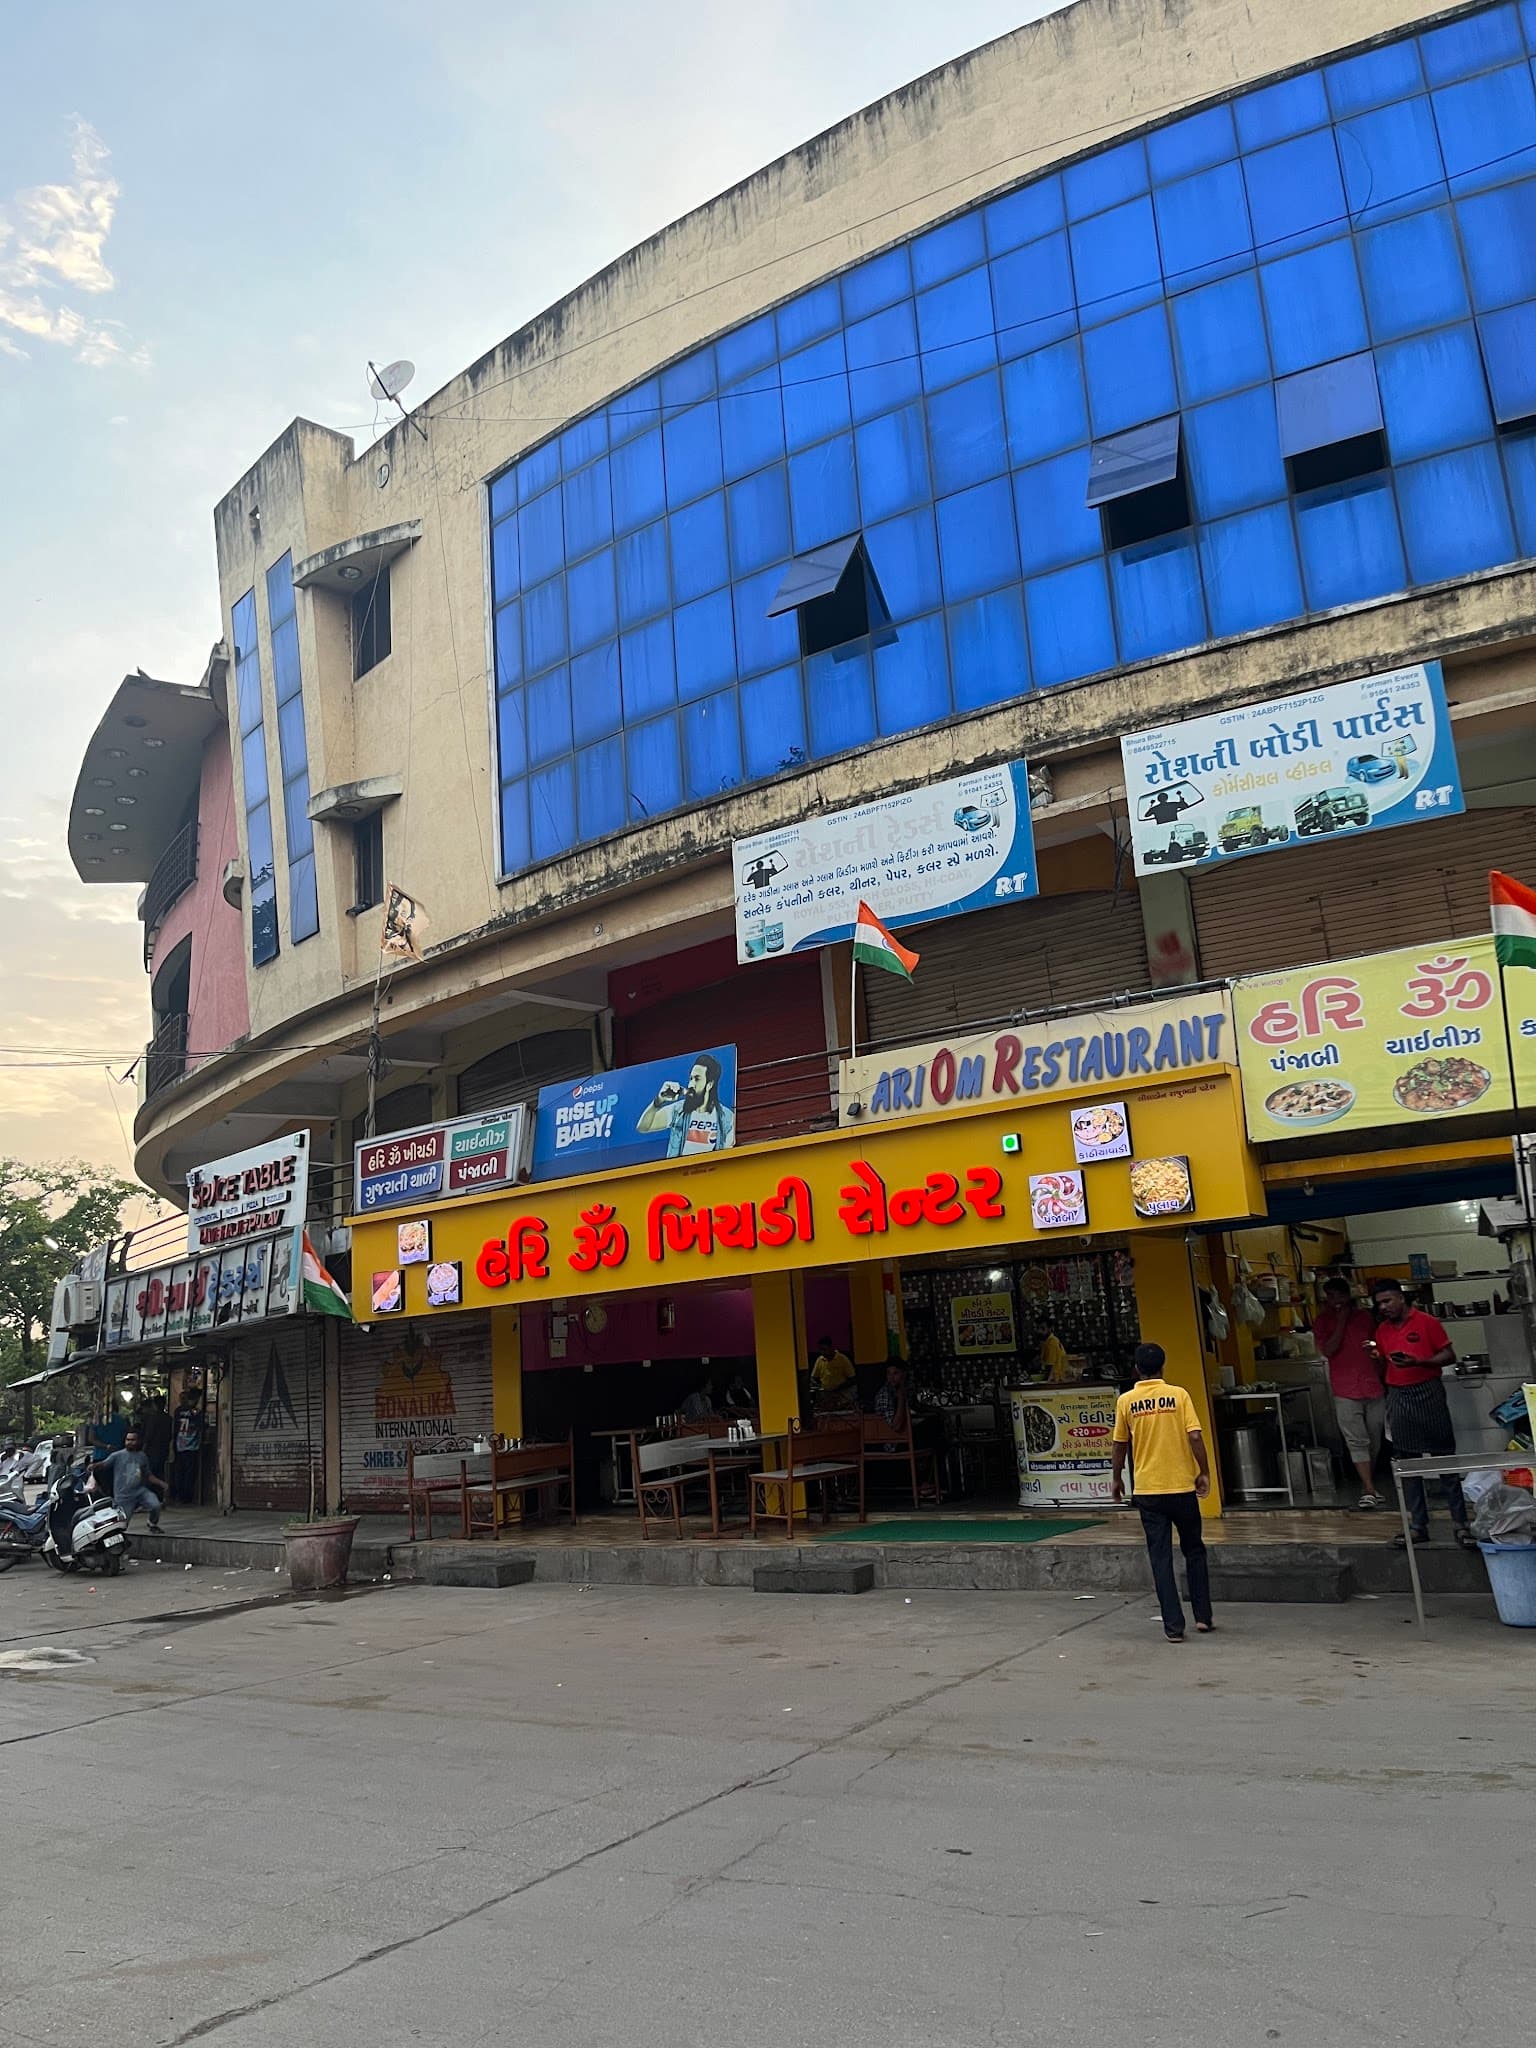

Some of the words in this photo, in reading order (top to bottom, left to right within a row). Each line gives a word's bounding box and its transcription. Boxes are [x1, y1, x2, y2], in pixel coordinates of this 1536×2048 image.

[1220, 714, 1245, 725] GSTIN
[1145, 738, 1240, 785] રોશની
[1250, 719, 1323, 758] બોડી
[1333, 697, 1426, 739] પાર્ટસ
[1415, 785, 1454, 810] RT
[827, 815, 849, 826] GSTIN
[917, 860, 942, 875] કલર
[994, 872, 1028, 897] RT
[1250, 977, 1365, 1045] હરિ
[1270, 1044, 1340, 1072] પંજાબી
[1386, 1025, 1481, 1054] ચાઈનીઝ
[871, 1064, 926, 1113] ARI
[991, 1013, 1226, 1095] RESTAURANT
[583, 1081, 604, 1096] pepsi
[556, 1099, 596, 1125] RISE
[596, 1093, 619, 1115] UP
[556, 1114, 614, 1149] BABY!
[689, 1120, 718, 1131] PEPS
[455, 1130, 506, 1152] ચાઈનીઝ
[368, 1149, 385, 1172] હરિ
[404, 1137, 437, 1161] ખીચડી
[458, 1157, 498, 1180] પંજાબી
[192, 1175, 241, 1209] SPICE
[241, 1155, 297, 1195] TABLE
[365, 1173, 408, 1205] ગુજરાતી
[477, 1215, 550, 1288] હરિ
[646, 1174, 815, 1262] ખિચડી
[839, 1160, 1005, 1235] સેન્ટર
[1130, 1399, 1155, 1414] HARI
[1159, 1397, 1176, 1408] OM
[375, 1418, 457, 1439] INTERNATIONAL
[363, 1451, 394, 1468] SHREE
[1088, 1481, 1113, 1497] પુલા
